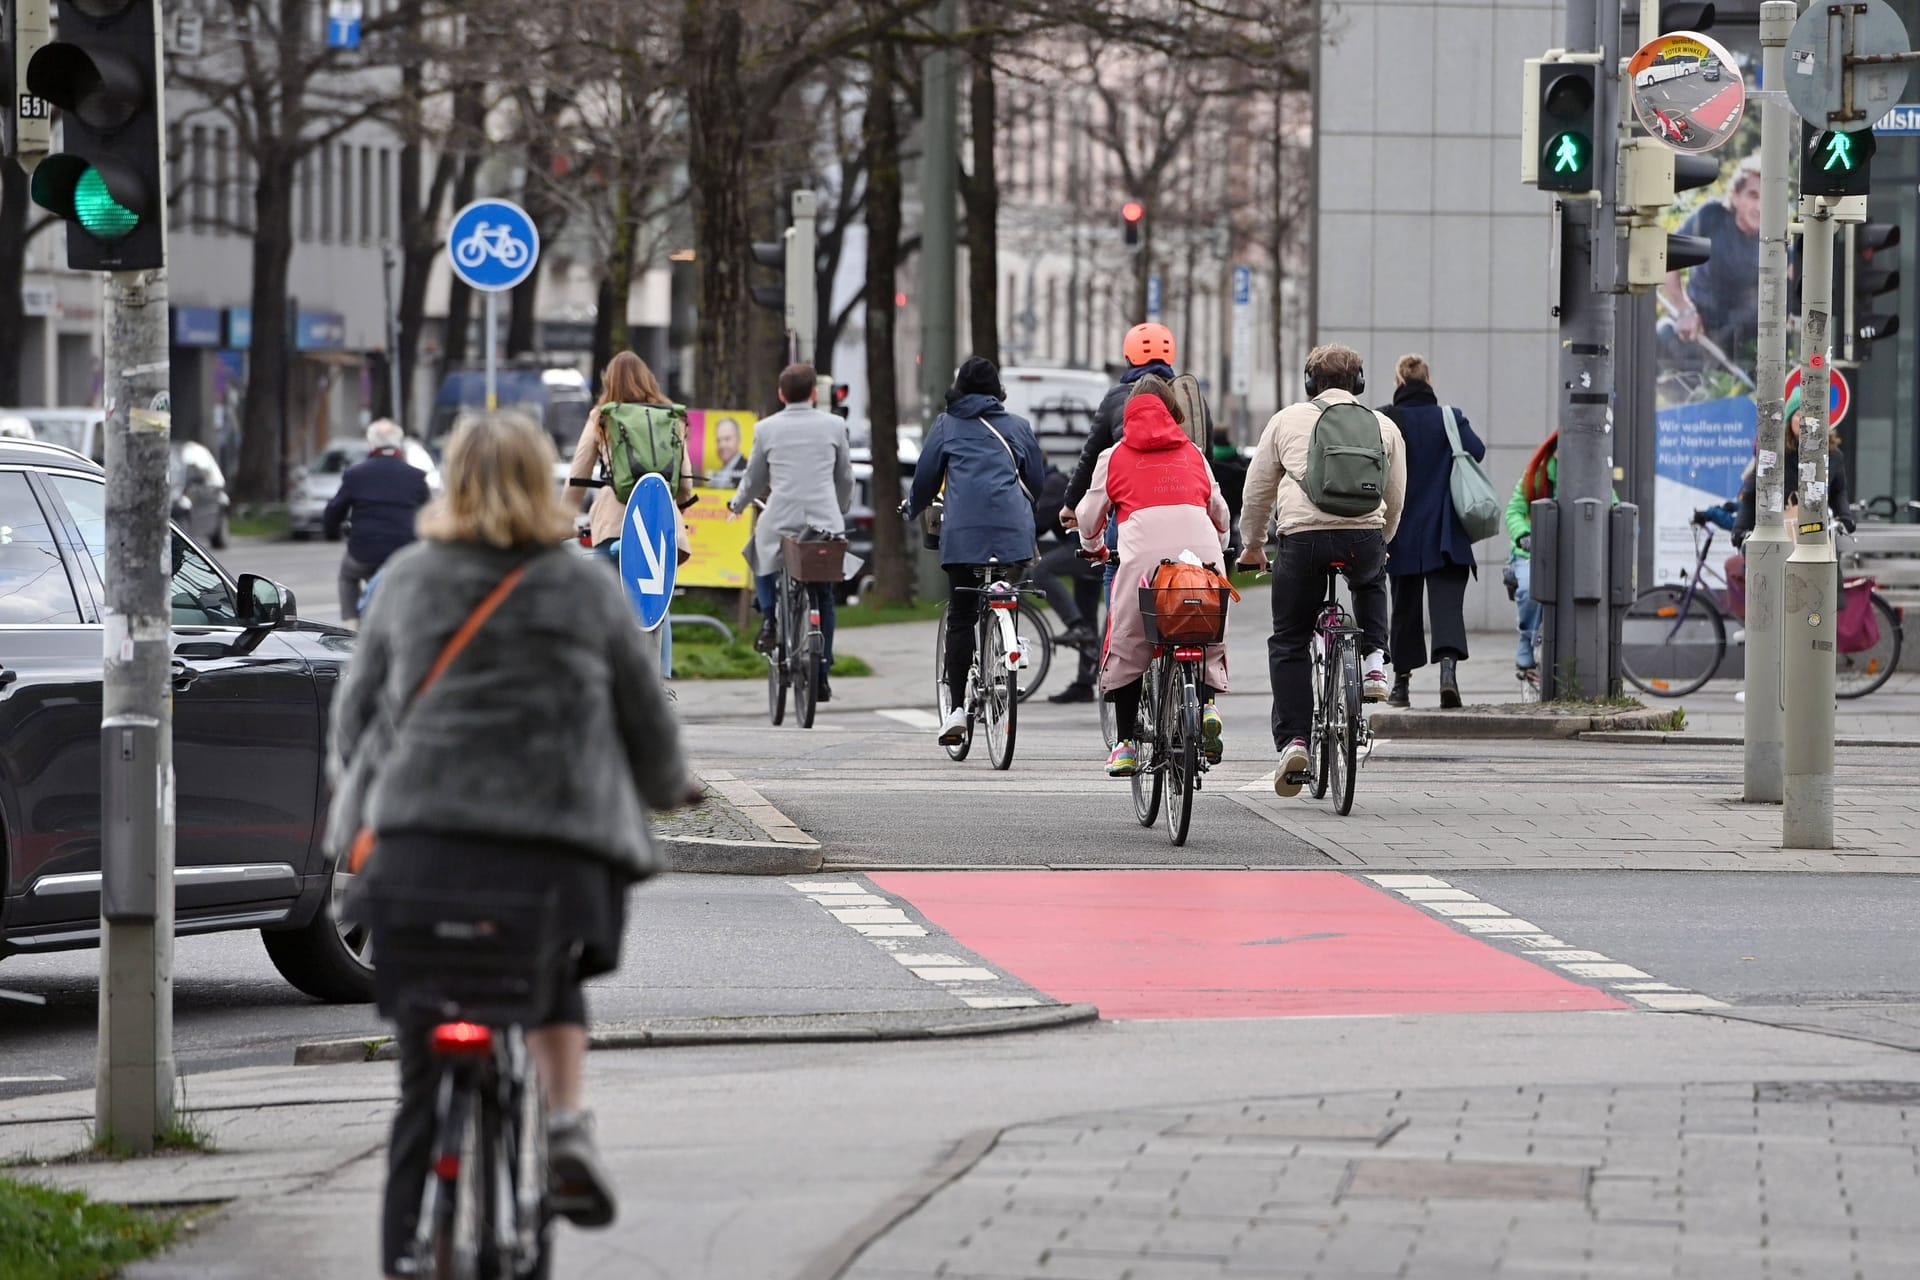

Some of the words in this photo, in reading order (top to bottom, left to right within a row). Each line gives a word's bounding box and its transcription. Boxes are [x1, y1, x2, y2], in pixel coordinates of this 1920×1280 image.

[1665, 47, 1682, 56] TOTER
[1683, 47, 1703, 56] WINKEL
[21, 96, 48, 117] 551
[1659, 420, 1679, 432] Wir
[1682, 420, 1721, 432] wollen
[1723, 421, 1743, 432] mit
[1660, 435, 1677, 447] der
[1680, 435, 1716, 447] Natur
[1659, 453, 1689, 465] Nicht
[1692, 455, 1730, 468] gegen
